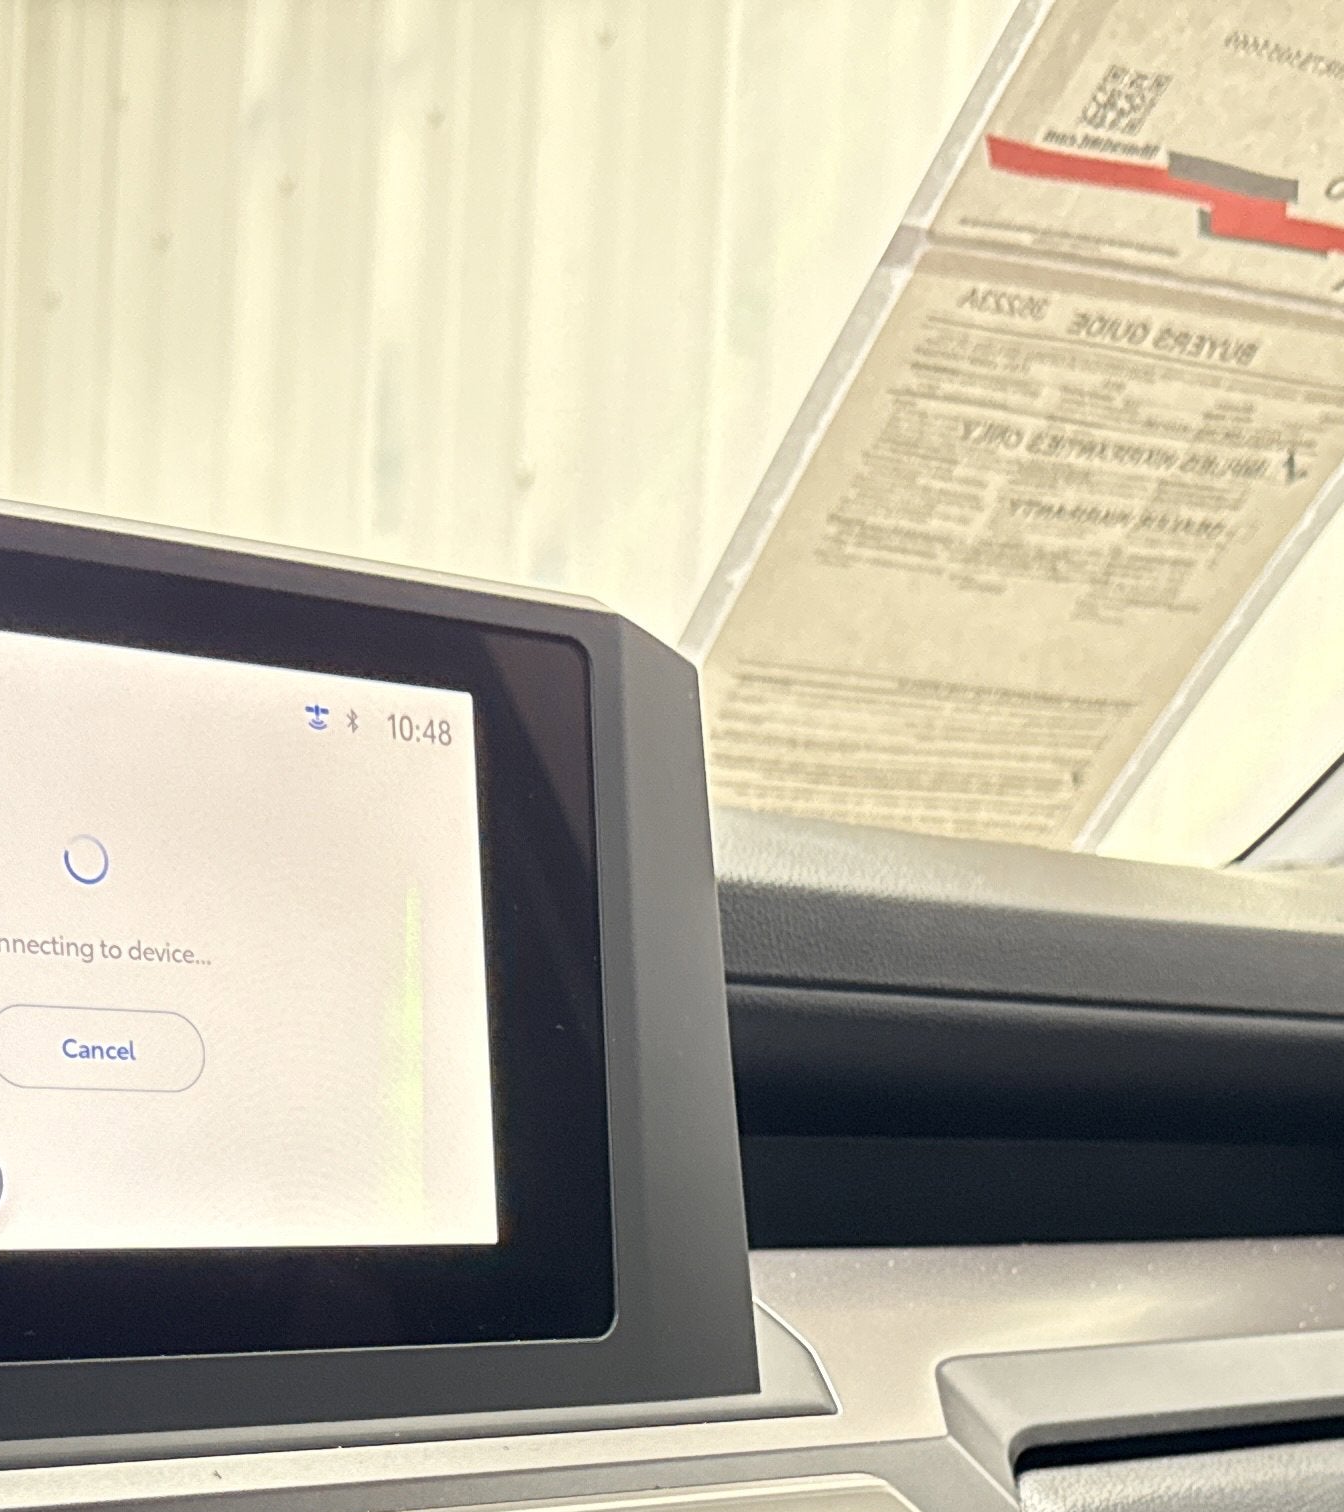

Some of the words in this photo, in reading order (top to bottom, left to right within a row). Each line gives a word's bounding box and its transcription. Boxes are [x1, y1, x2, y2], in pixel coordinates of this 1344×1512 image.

[387, 713, 452, 746] 10:48
[99, 941, 123, 961] to
[128, 940, 212, 966] device...
[61, 1037, 137, 1061] Cancel
